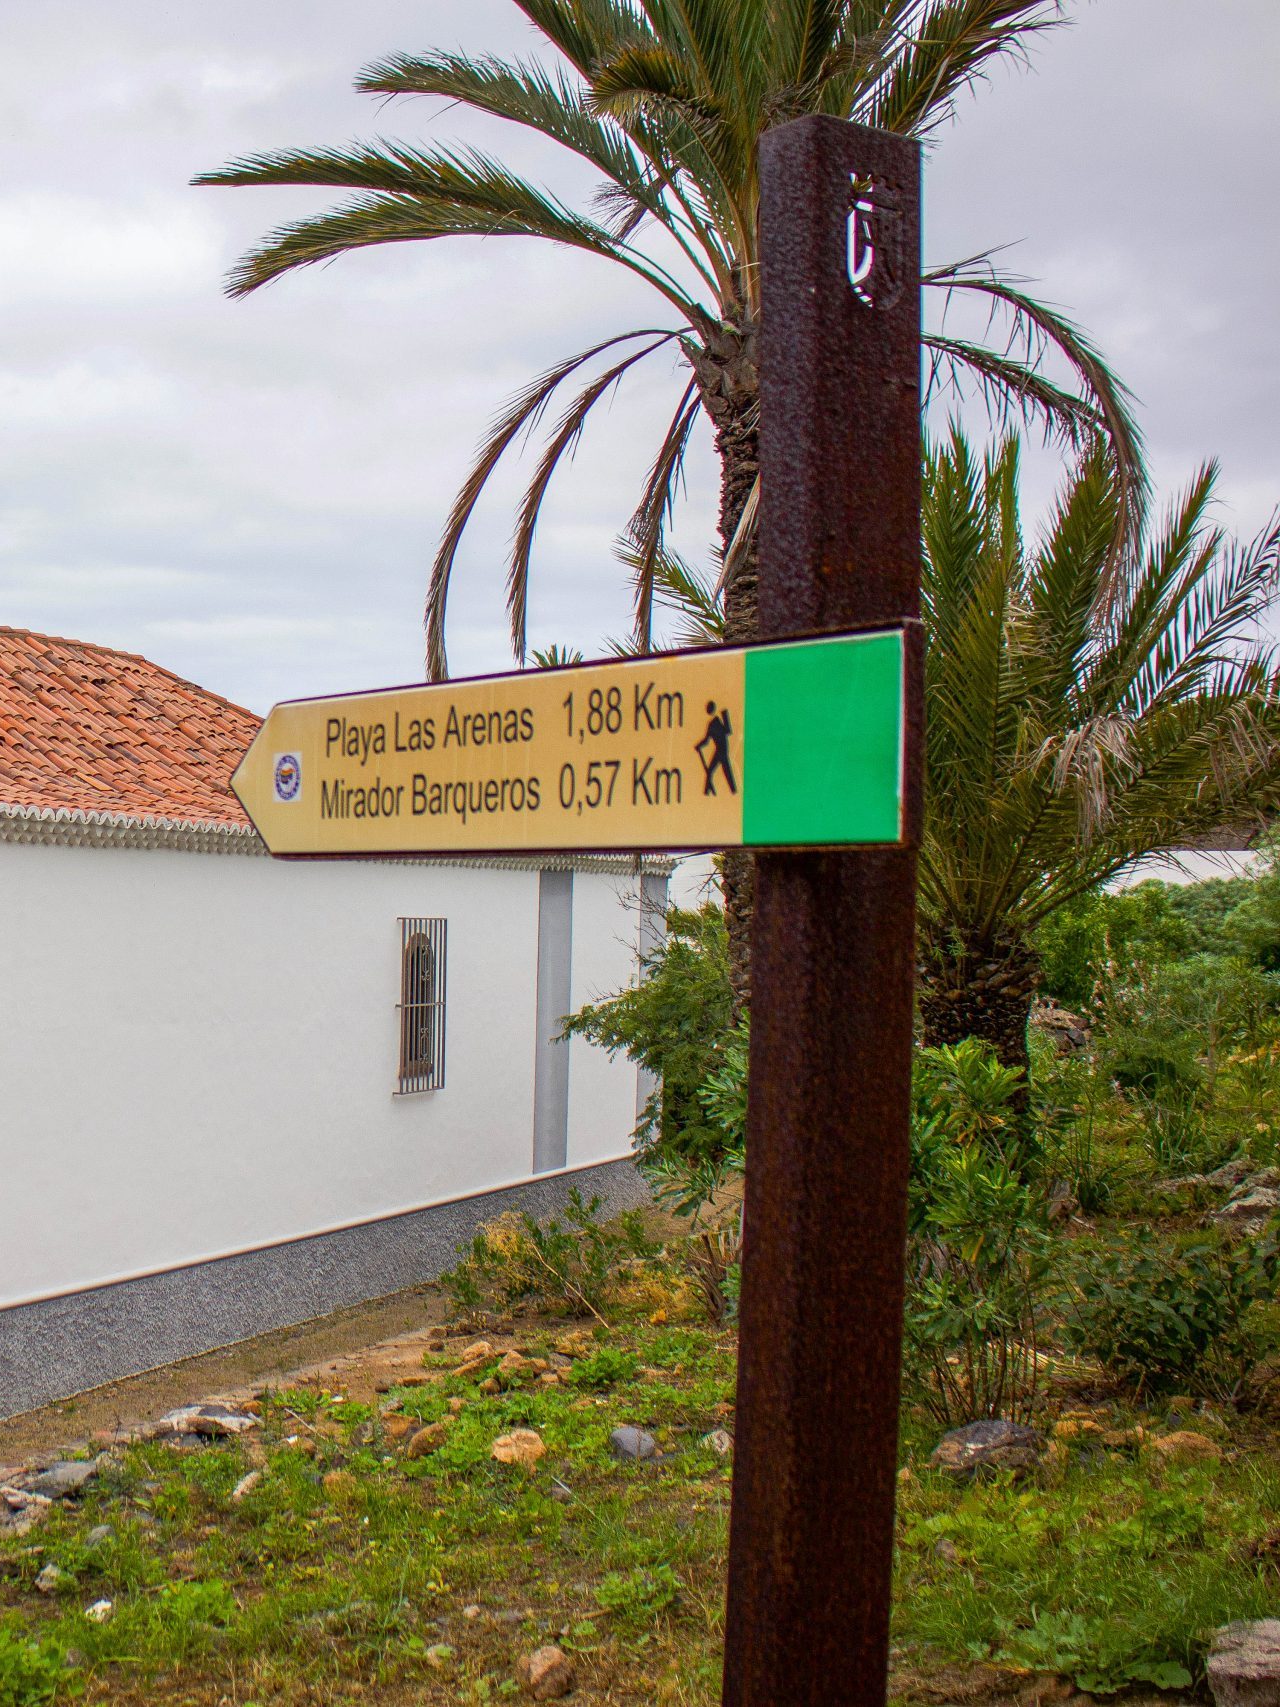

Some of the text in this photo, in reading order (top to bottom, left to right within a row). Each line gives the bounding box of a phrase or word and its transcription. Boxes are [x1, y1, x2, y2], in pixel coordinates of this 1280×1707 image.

[326, 681, 684, 767] Playa Las Arenas 1,88 Km
[321, 776, 405, 819] Mirador
[411, 773, 541, 825] Barqueros
[558, 759, 621, 817] 0,57
[632, 756, 682, 806] Km
